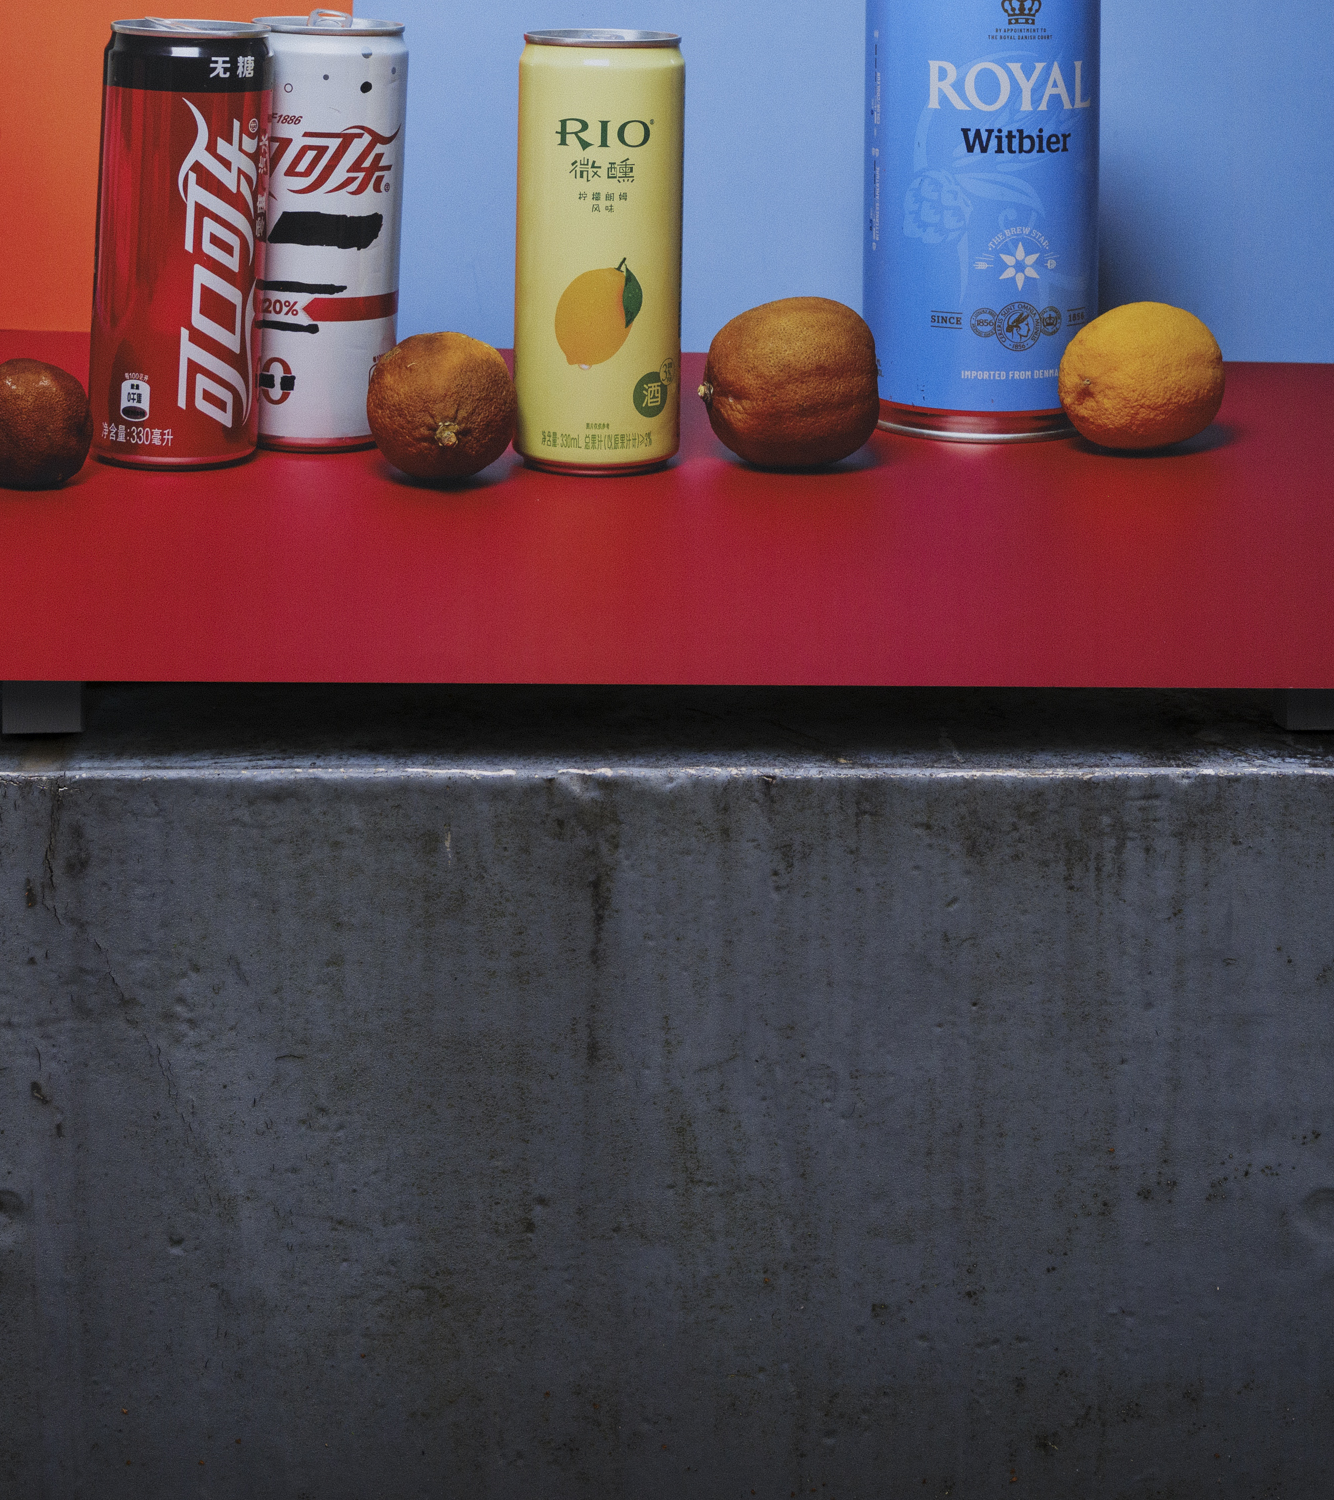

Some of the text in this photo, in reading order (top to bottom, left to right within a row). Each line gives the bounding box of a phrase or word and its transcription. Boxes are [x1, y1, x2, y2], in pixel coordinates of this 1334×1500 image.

[210, 56, 255, 78] 无糖
[927, 60, 1091, 112] ROYAL
[555, 117, 651, 152] RIO
[960, 128, 1071, 153] Witbier
[569, 156, 636, 184] 微醺
[591, 203, 615, 213] 风味
[988, 226, 1049, 249] THE BREW STAR
[178, 97, 260, 428] 可口可乐
[930, 314, 963, 326] SINCE
[976, 319, 995, 327] 1856
[1068, 311, 1086, 323] 1856
[961, 370, 1006, 380] IMPORTED
[1009, 370, 1032, 380] FROM
[642, 381, 661, 407] 酒
